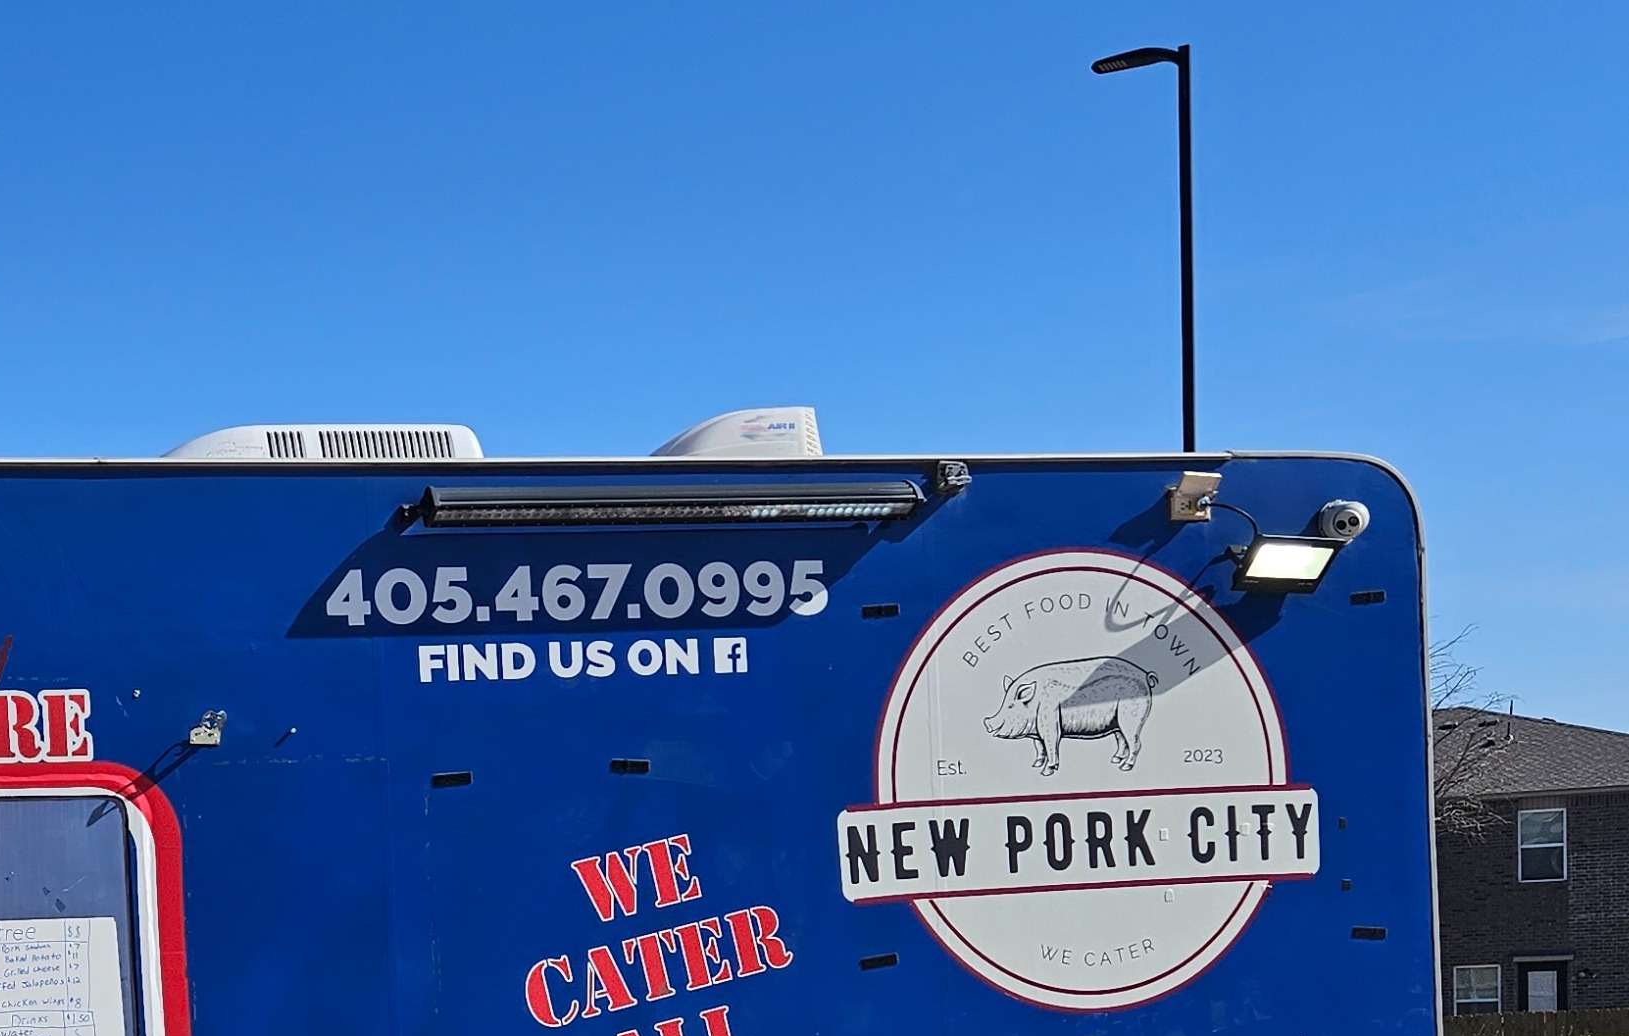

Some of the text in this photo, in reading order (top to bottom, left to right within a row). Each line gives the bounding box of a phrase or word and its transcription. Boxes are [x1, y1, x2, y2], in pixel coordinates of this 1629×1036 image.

[326, 560, 829, 626] 405.467.0995
[418, 641, 536, 683] FIND
[548, 641, 617, 679] US
[626, 638, 700, 676] ON
[962, 593, 1201, 676] BEST FOOD IN TOWN
[937, 760, 968, 776] Est.
[1183, 748, 1224, 764] 2023
[846, 803, 1314, 885] NEW PORK CITY
[571, 833, 702, 922] WE
[525, 905, 794, 1028] CATER
[1040, 937, 1156, 967] WE CATER
